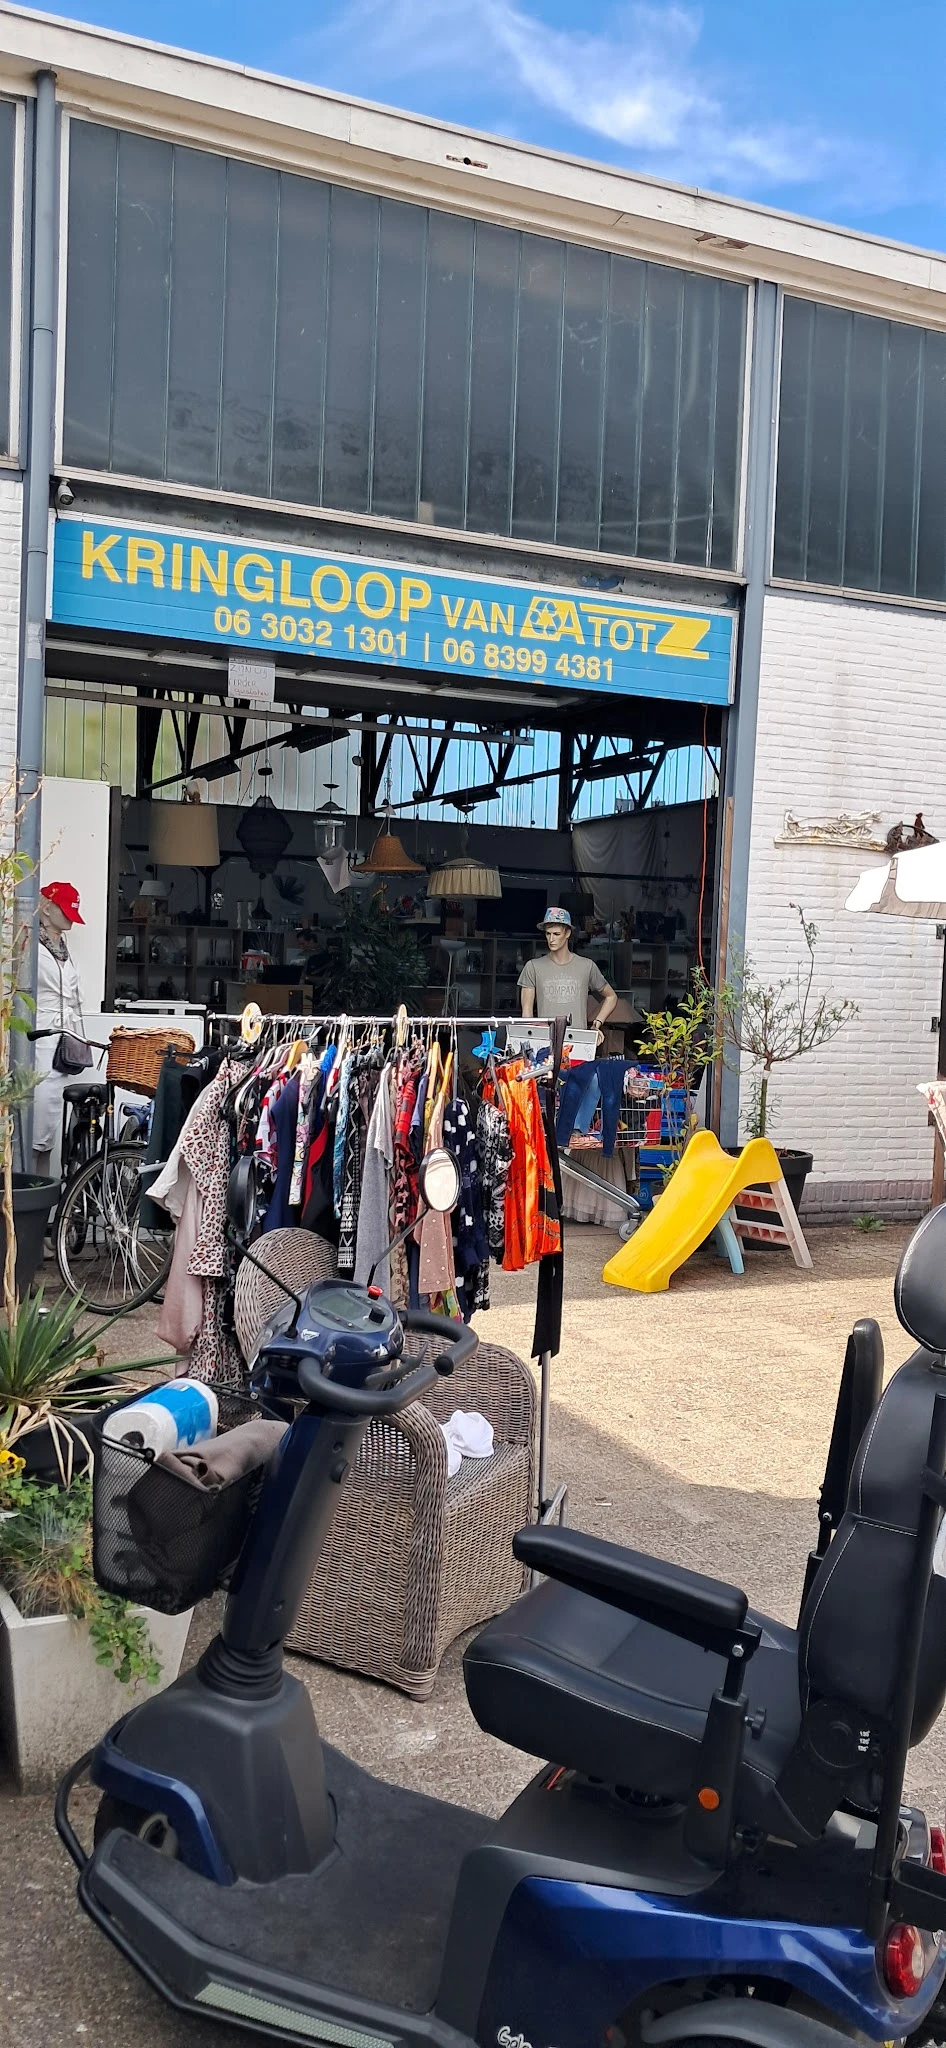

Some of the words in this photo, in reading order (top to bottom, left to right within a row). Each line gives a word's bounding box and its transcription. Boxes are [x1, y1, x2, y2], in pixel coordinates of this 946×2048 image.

[81, 530, 432, 622] KRINGLOOP
[441, 595, 514, 636] VAN
[588, 616, 656, 653] TOT
[214, 606, 250, 635] 06
[261, 613, 332, 647] 3032
[343, 624, 407, 656] 1301
[443, 638, 475, 665] 06
[483, 643, 547, 673] 8399
[555, 653, 613, 681] 4381
